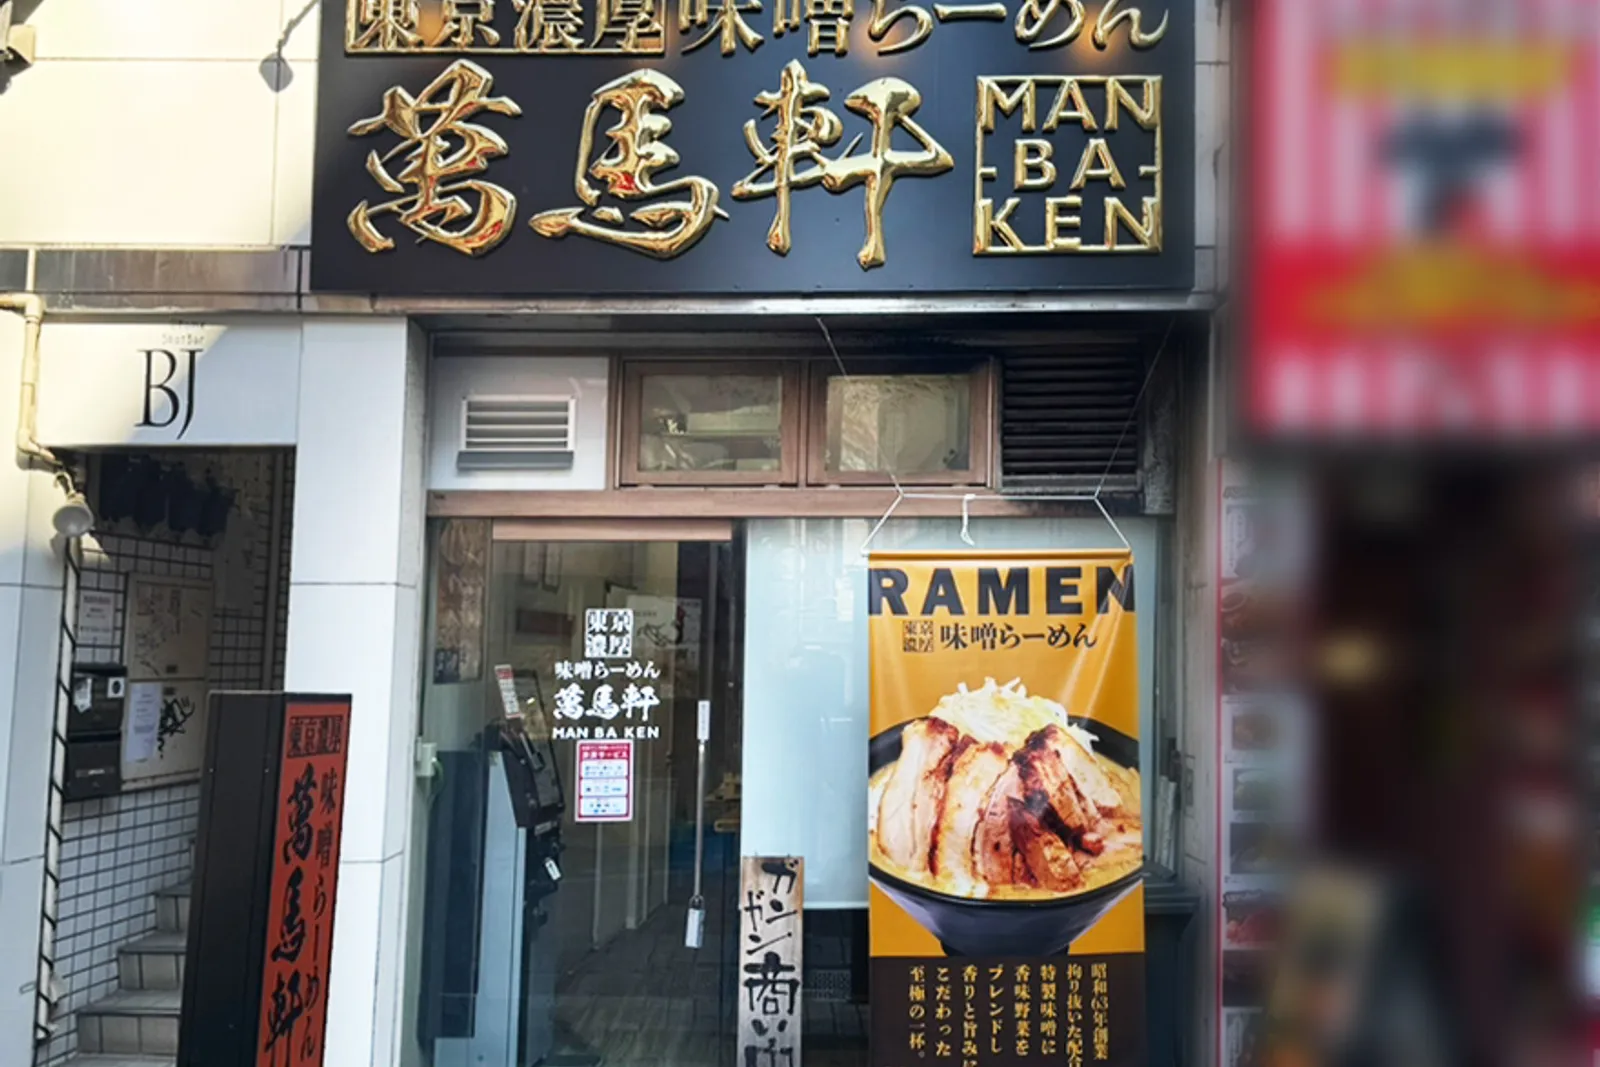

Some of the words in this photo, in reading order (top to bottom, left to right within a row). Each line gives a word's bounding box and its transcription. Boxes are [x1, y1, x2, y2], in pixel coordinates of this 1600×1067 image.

[347, 0, 662, 51] 東京濃厚
[678, 0, 1168, 56] 味噌らーめん
[977, 75, 1163, 132] MAN
[347, 58, 955, 271] 萬馬軒
[1014, 138, 1127, 191] BA
[974, 197, 1163, 256] KEN
[134, 348, 205, 440] BJ
[868, 564, 1136, 616] RAMEN
[940, 622, 1098, 650] 味噌らーめん
[554, 660, 661, 680] 味噌らーめん
[552, 682, 661, 721] 萬馬軒
[552, 726, 589, 739] MAN
[594, 726, 618, 739] BA
[623, 726, 660, 739] KEN
[264, 762, 317, 1067] 萬馬軒
[300, 766, 338, 1062] 味噌らーめん
[935, 967, 952, 1056] こだわった
[989, 963, 1004, 1053] ブレンドし
[1013, 964, 1031, 1056] 香味野菜を
[1040, 964, 1057, 1054] 特製味噌に
